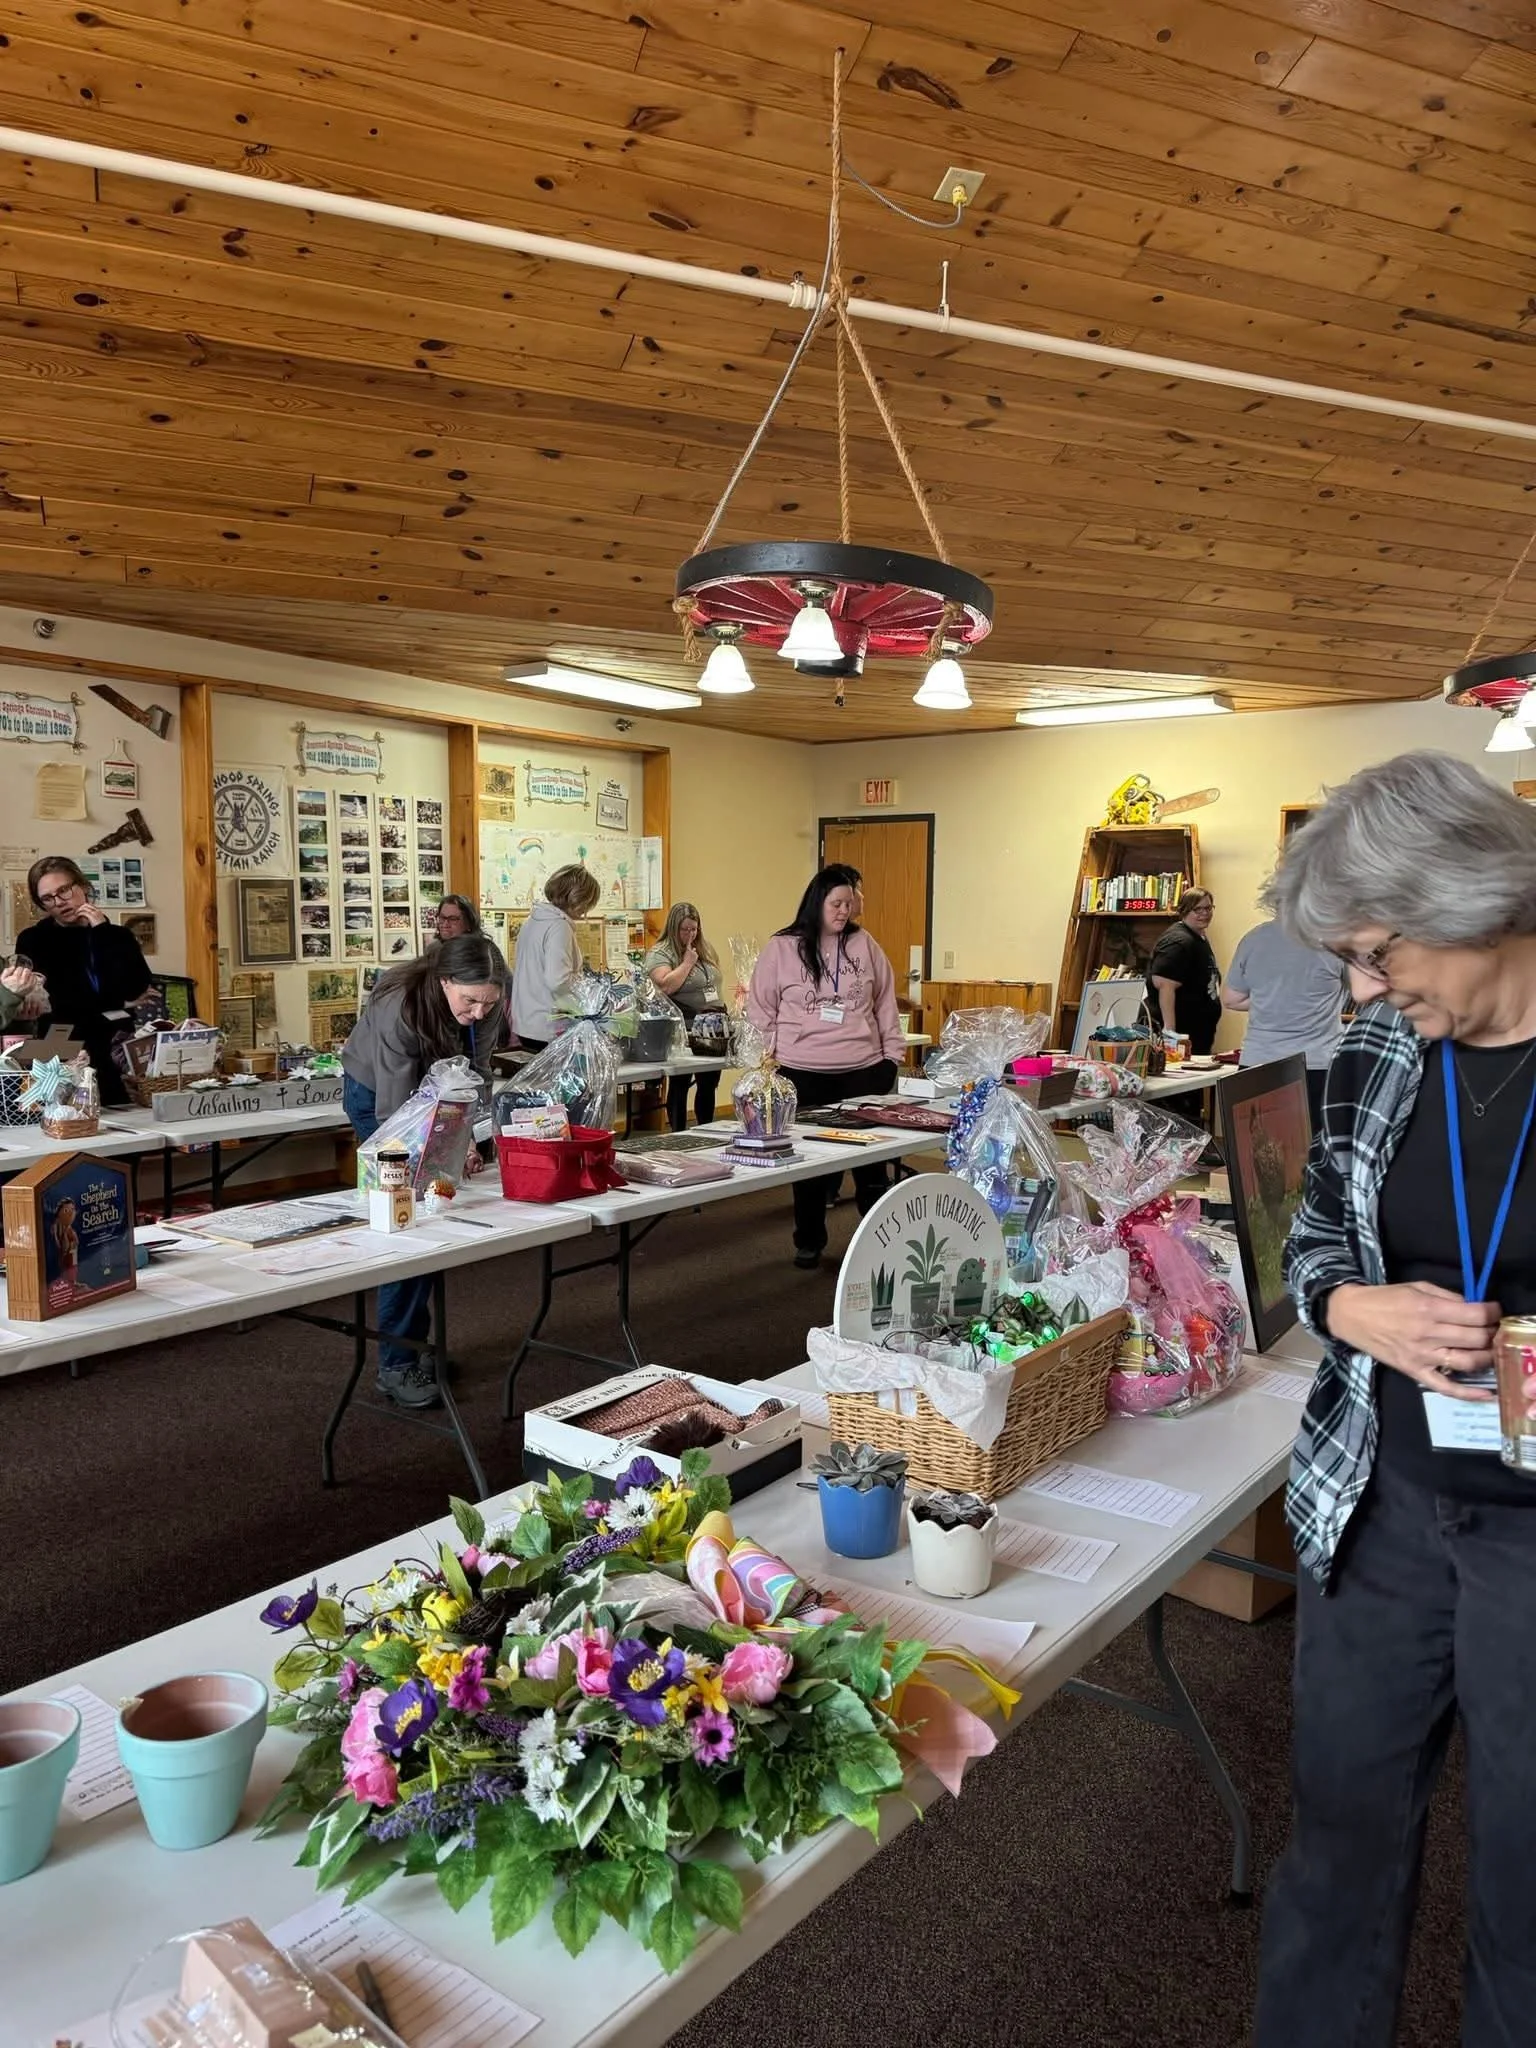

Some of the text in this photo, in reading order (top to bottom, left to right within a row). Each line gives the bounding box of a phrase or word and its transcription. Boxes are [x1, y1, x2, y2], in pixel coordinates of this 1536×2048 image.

[22, 717, 33, 734] the
[35, 720, 47, 735] mid
[246, 775, 281, 817] SPRINGS
[866, 780, 890, 803] EXIT
[251, 831, 281, 866] RANCH
[188, 1083, 344, 1117] Unfailing Love
[81, 1184, 117, 1206] Shepherd
[82, 1205, 119, 1228] Search
[874, 1193, 986, 1249] IT'S NOT HOARDING
